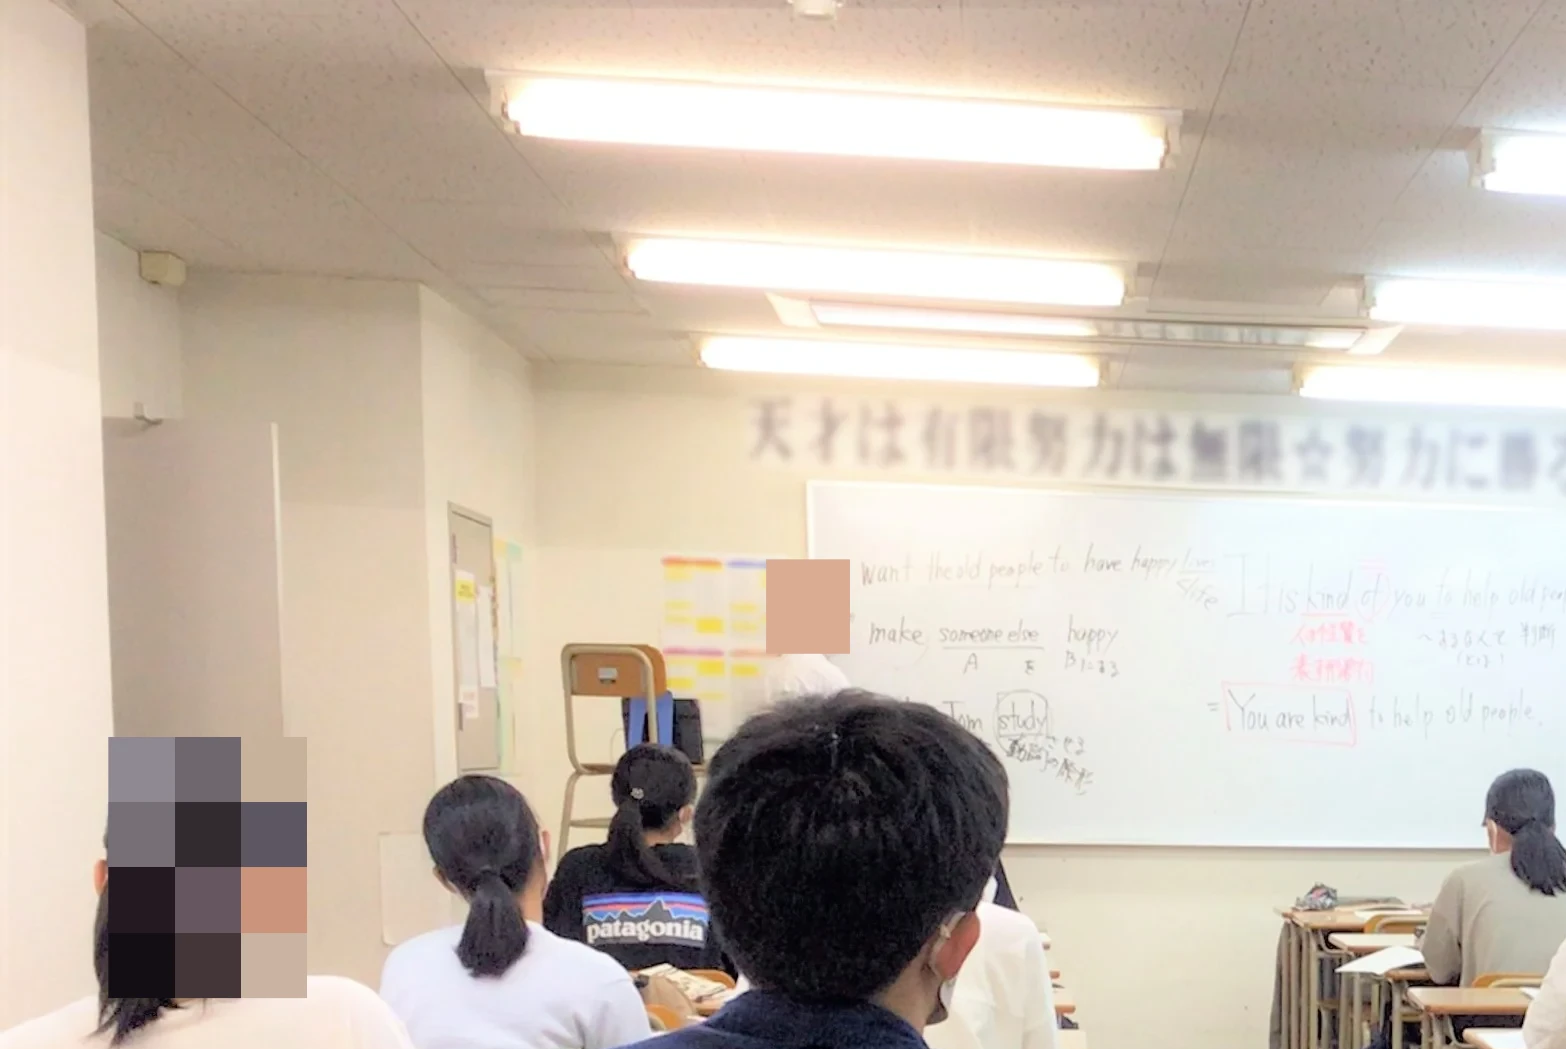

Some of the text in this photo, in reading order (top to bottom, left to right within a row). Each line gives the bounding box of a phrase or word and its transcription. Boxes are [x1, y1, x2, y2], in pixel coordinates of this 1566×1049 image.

[988, 550, 1043, 590] people
[1049, 545, 1070, 573] to
[1084, 542, 1122, 572] have
[1130, 544, 1178, 580] happy
[1278, 588, 1298, 614] is
[1306, 563, 1353, 610] kind
[1391, 588, 1426, 621] you
[1463, 568, 1499, 620] help
[1509, 574, 1537, 606] old
[869, 614, 1119, 653] make someone else happy
[963, 653, 978, 674] A
[998, 700, 1048, 735] study
[1228, 688, 1269, 731] You
[1275, 709, 1305, 730] are
[1312, 694, 1352, 731] kind
[1368, 695, 1384, 730] to
[1393, 692, 1434, 740] help
[1446, 686, 1473, 725] old
[586, 919, 704, 944] patagonia
